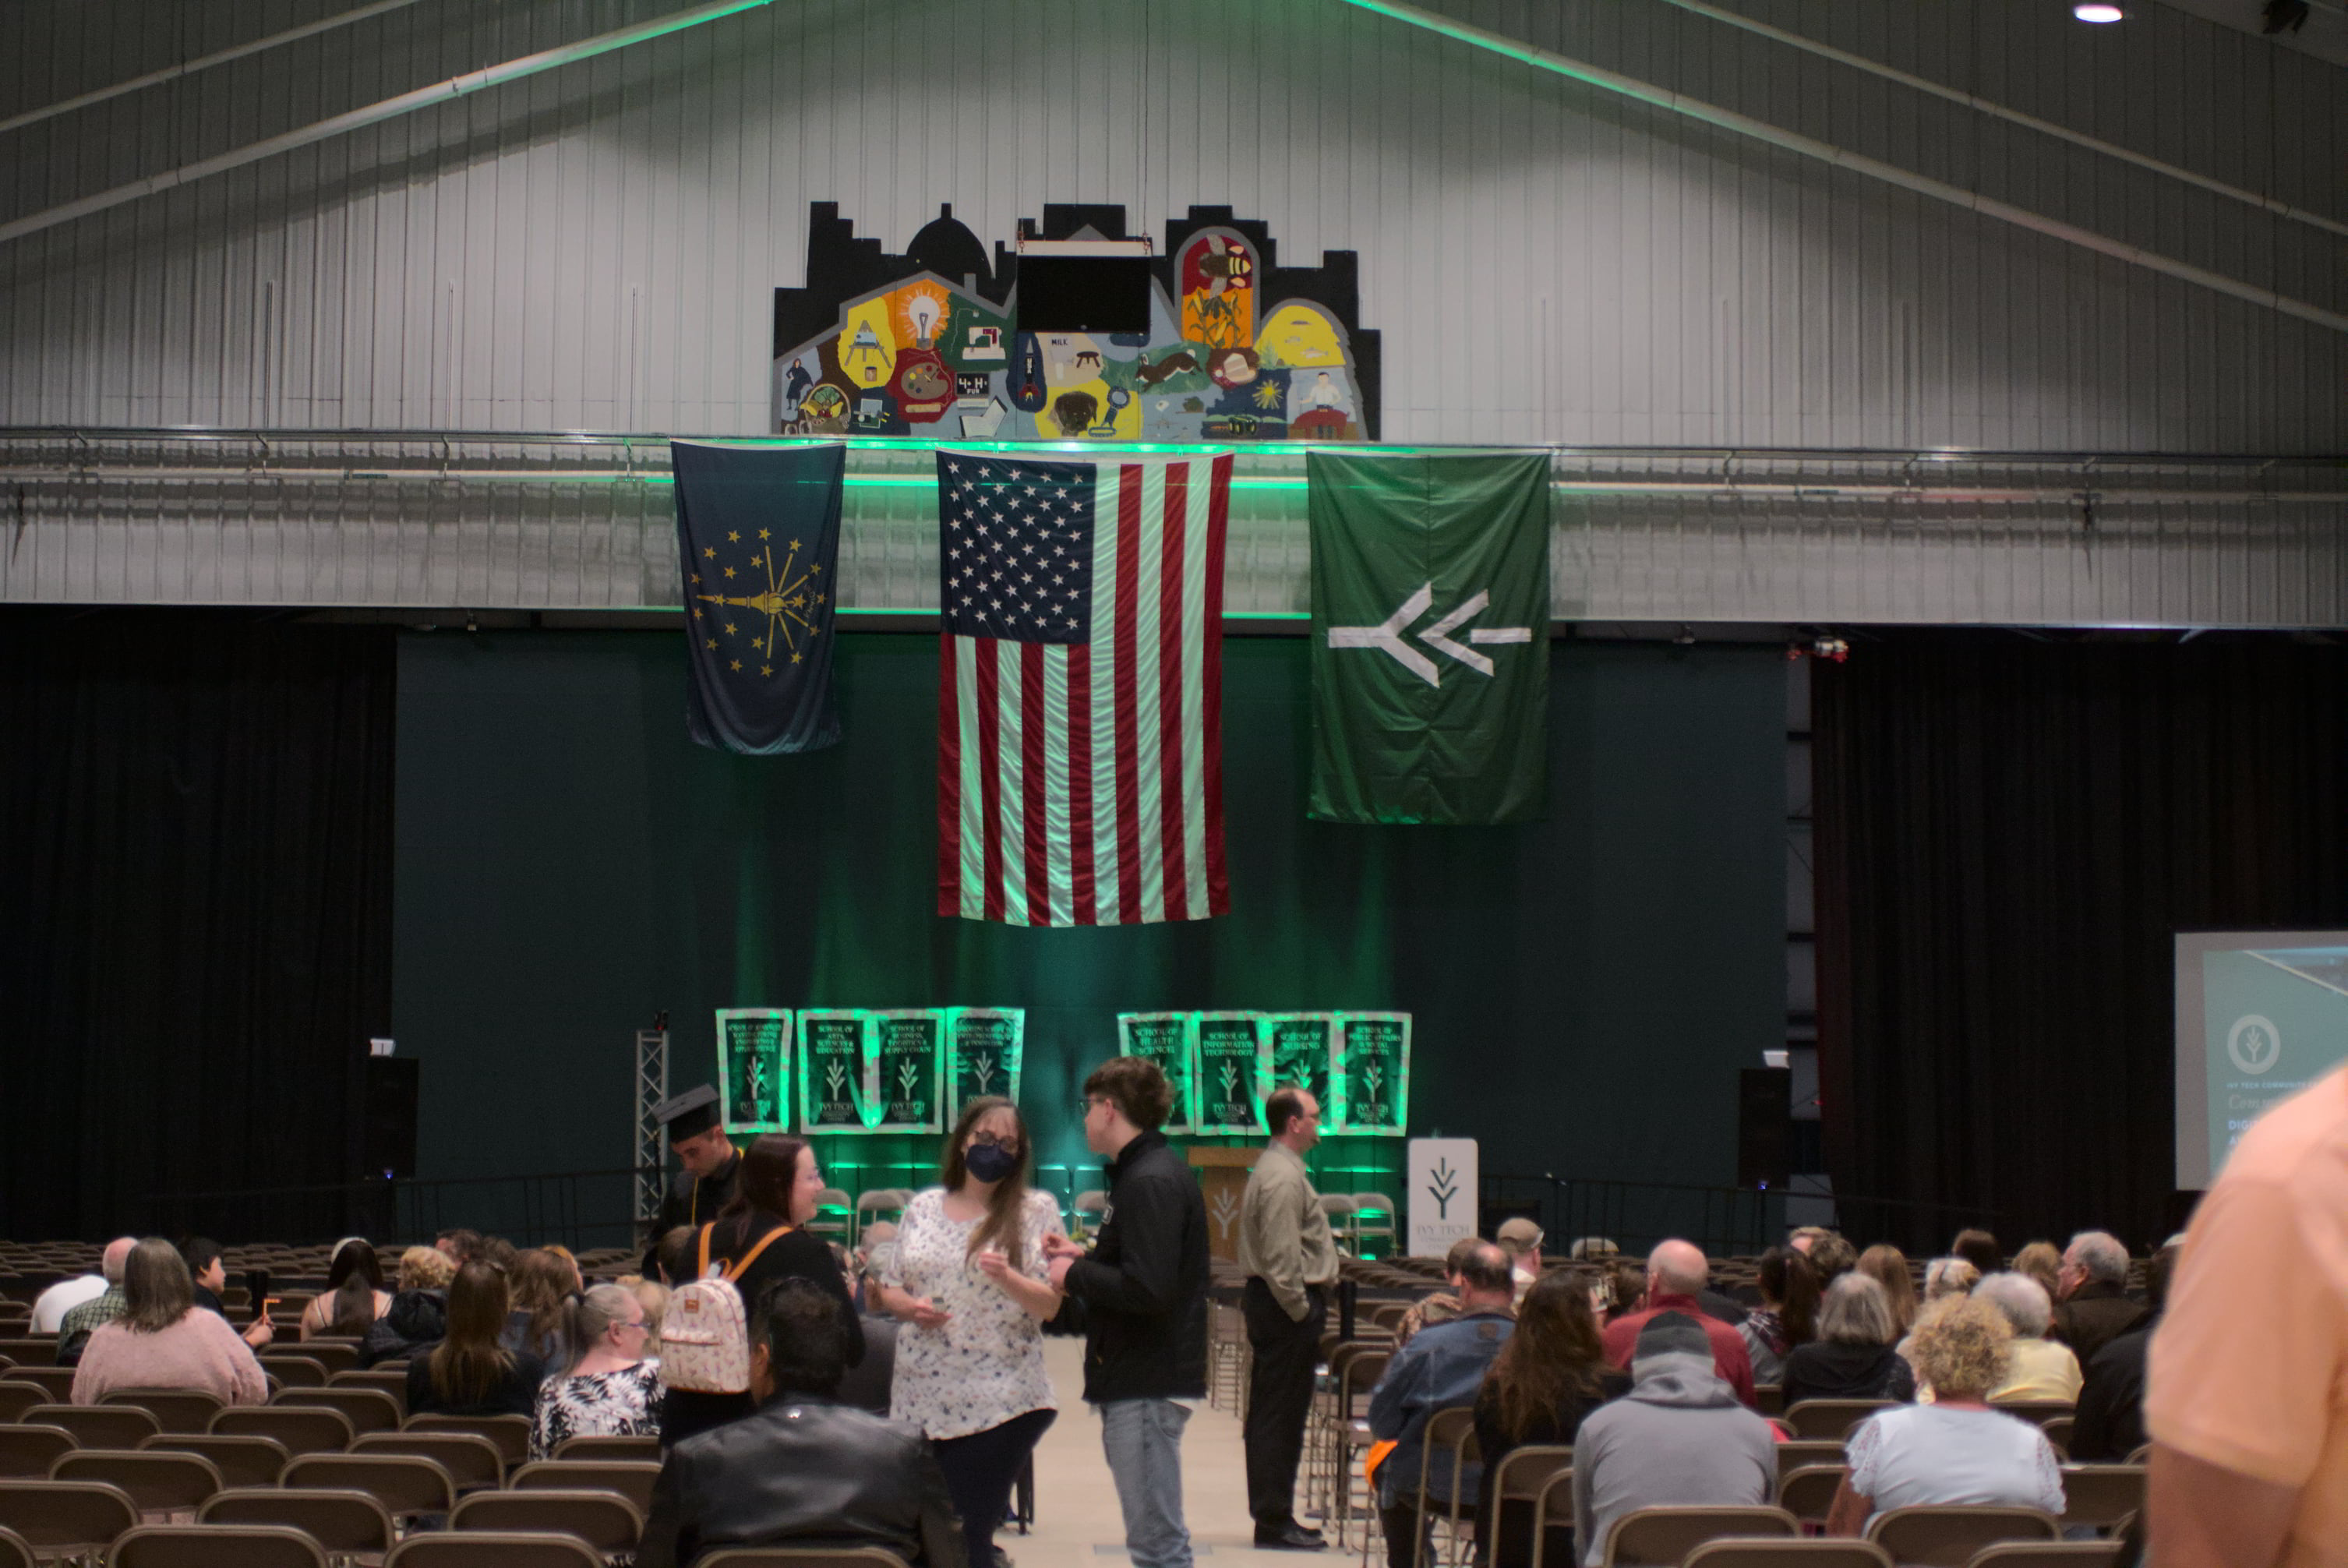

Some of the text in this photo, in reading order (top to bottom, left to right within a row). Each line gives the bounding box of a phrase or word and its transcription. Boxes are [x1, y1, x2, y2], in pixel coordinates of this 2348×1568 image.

[1135, 1028, 1166, 1037] SCHOOL
[1209, 1032, 1237, 1040] SCHOOL
[1280, 1033, 1308, 1041] SCHOOL
[1139, 1037, 1174, 1046] HEALTH
[1202, 1040, 1255, 1048] INFORMATION
[1282, 1041, 1321, 1051] NURSING
[1205, 1048, 1254, 1057] TECHNOLOGY
[819, 1102, 854, 1111] IVY TECH
[892, 1102, 905, 1111] IVY
[1213, 1104, 1226, 1112] IVY
[1356, 1104, 1369, 1112] IVY
[1417, 1224, 1470, 1235] IVY TECH
